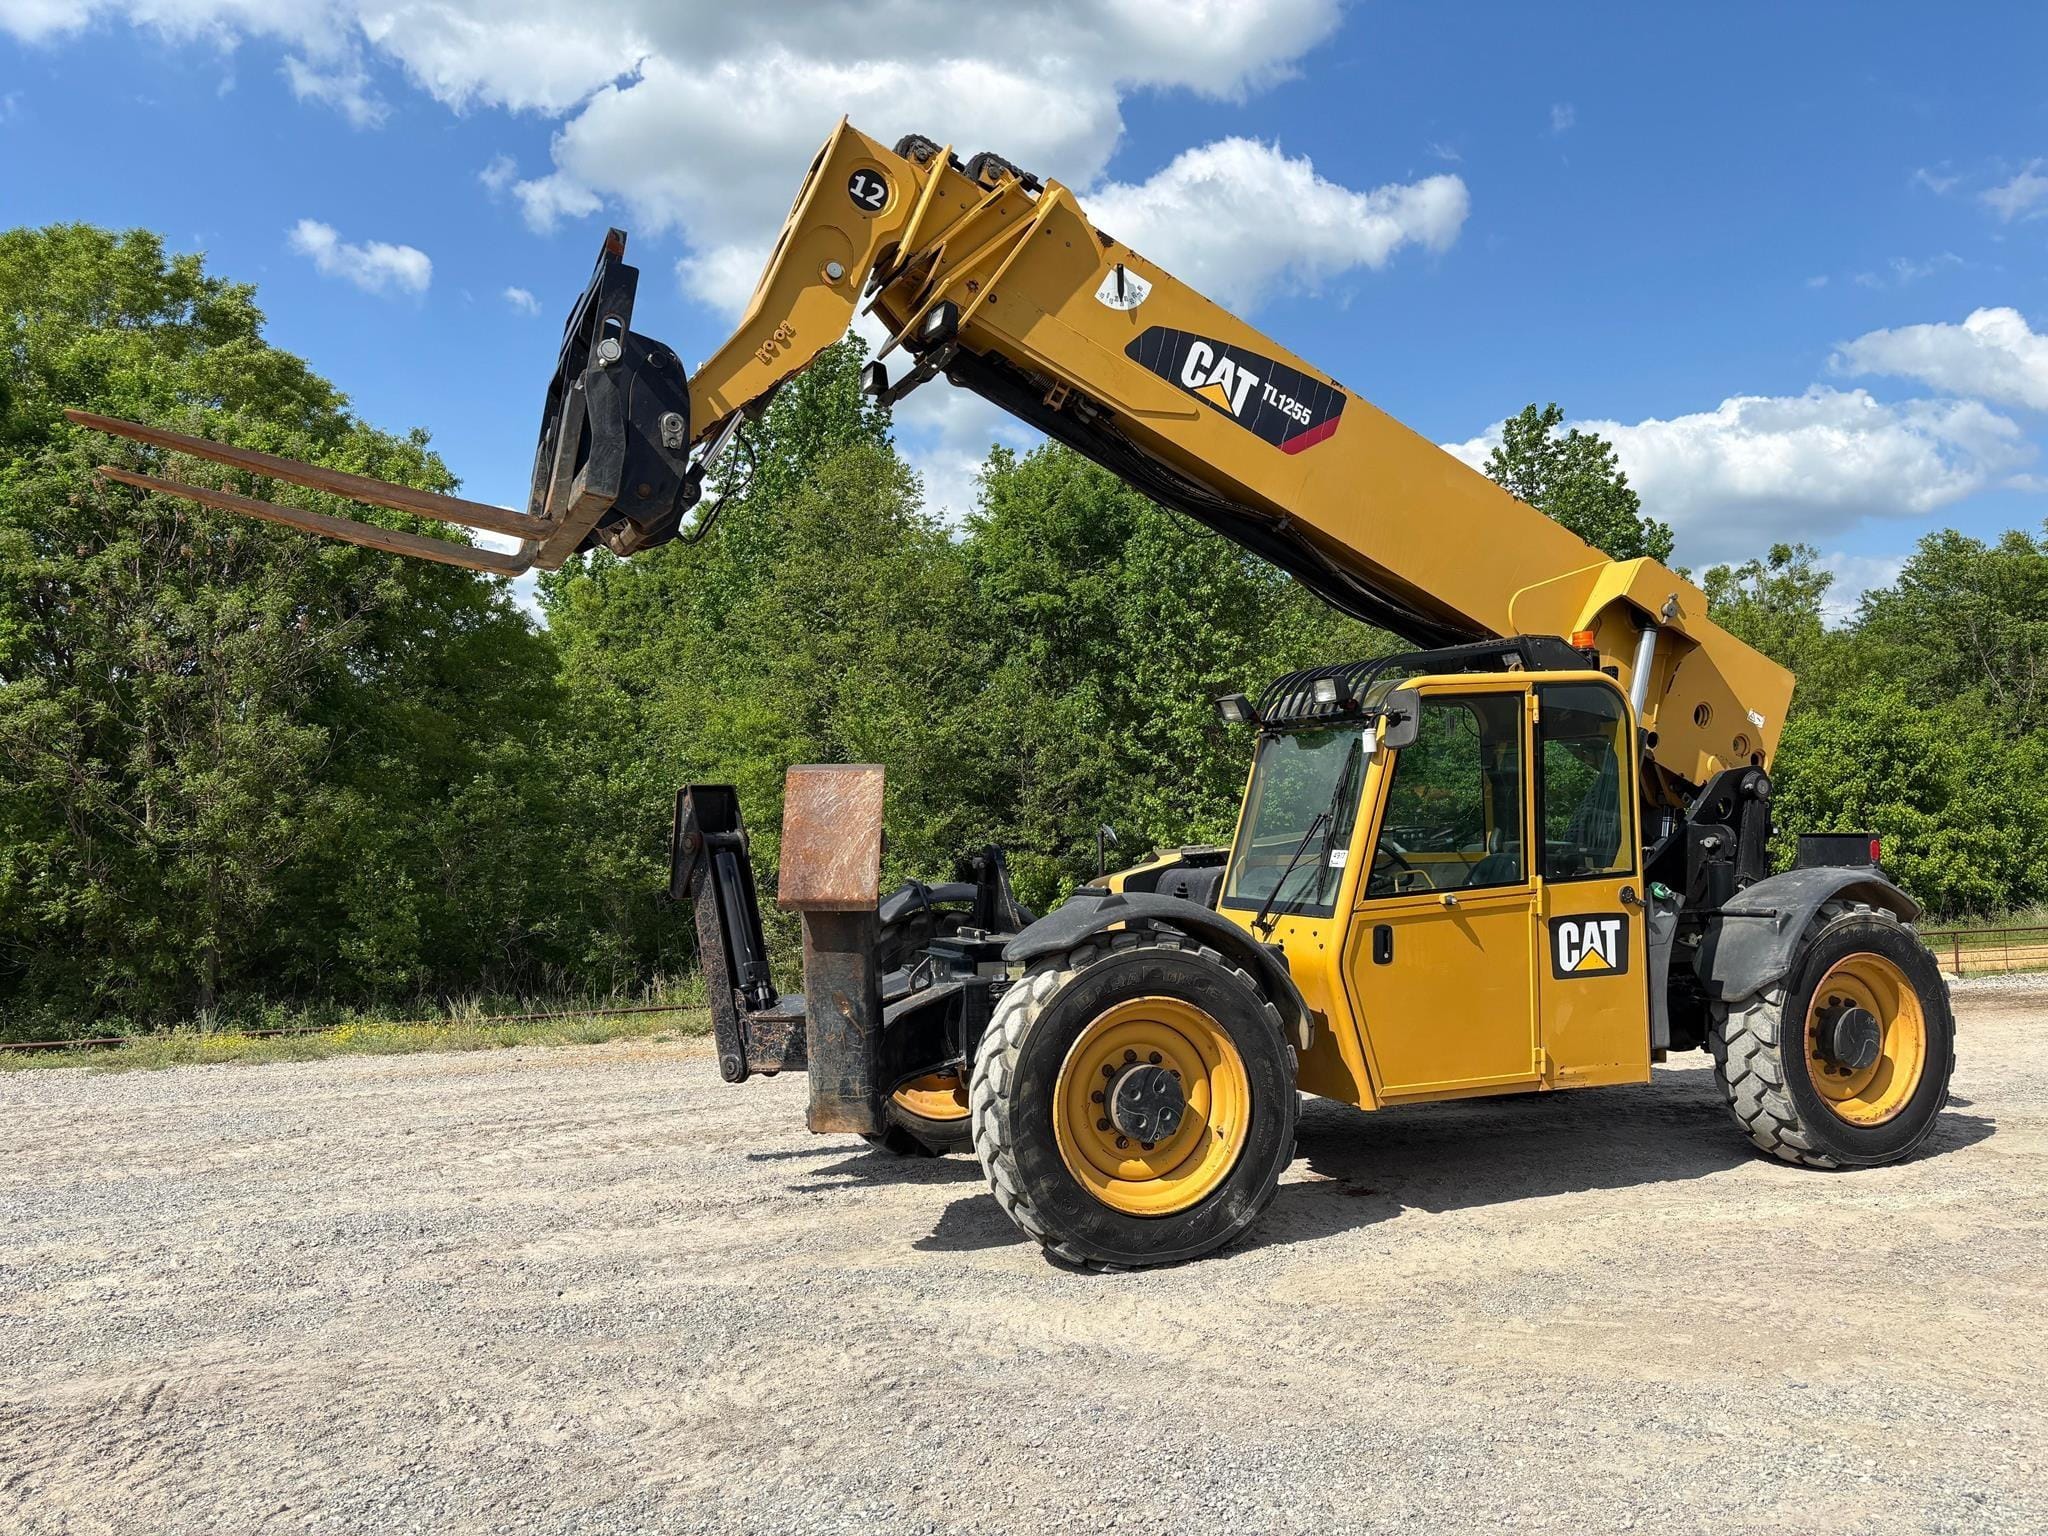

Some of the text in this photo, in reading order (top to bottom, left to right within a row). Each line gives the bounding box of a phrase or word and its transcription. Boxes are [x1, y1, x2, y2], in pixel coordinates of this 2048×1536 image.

[850, 175, 885, 208] 12
[1181, 341, 1312, 425] CAT TL1255
[1558, 919, 1621, 972] CAT
